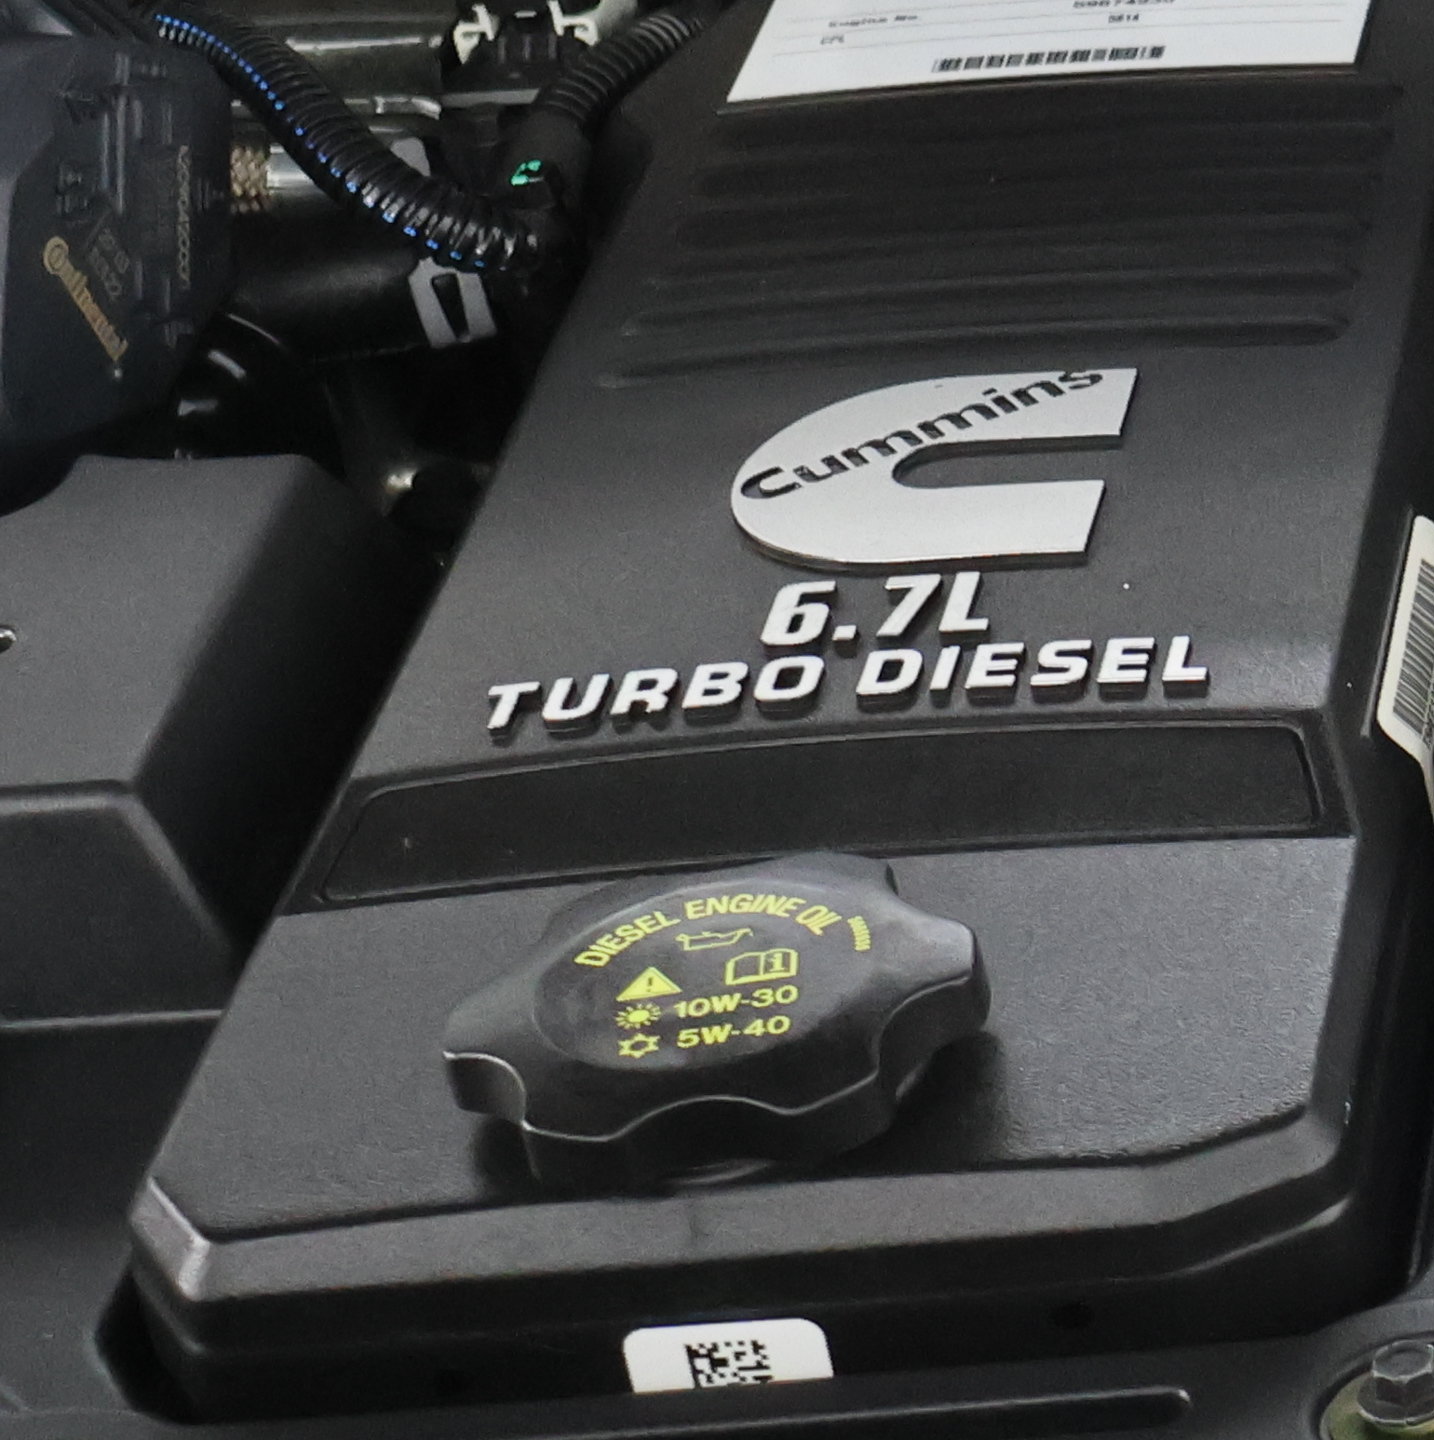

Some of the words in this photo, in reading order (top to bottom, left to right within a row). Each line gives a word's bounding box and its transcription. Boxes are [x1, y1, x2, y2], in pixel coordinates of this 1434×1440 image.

[739, 368, 1105, 501] Cummins
[759, 570, 991, 649] 6.7L
[486, 654, 826, 738] TURBO
[855, 634, 1209, 702] DIESEL
[573, 910, 682, 968] DIESEL
[684, 893, 807, 920] ENGINE
[795, 905, 843, 937] OIL
[672, 984, 800, 1019] 10W-30
[676, 1014, 791, 1049] 5W-40
